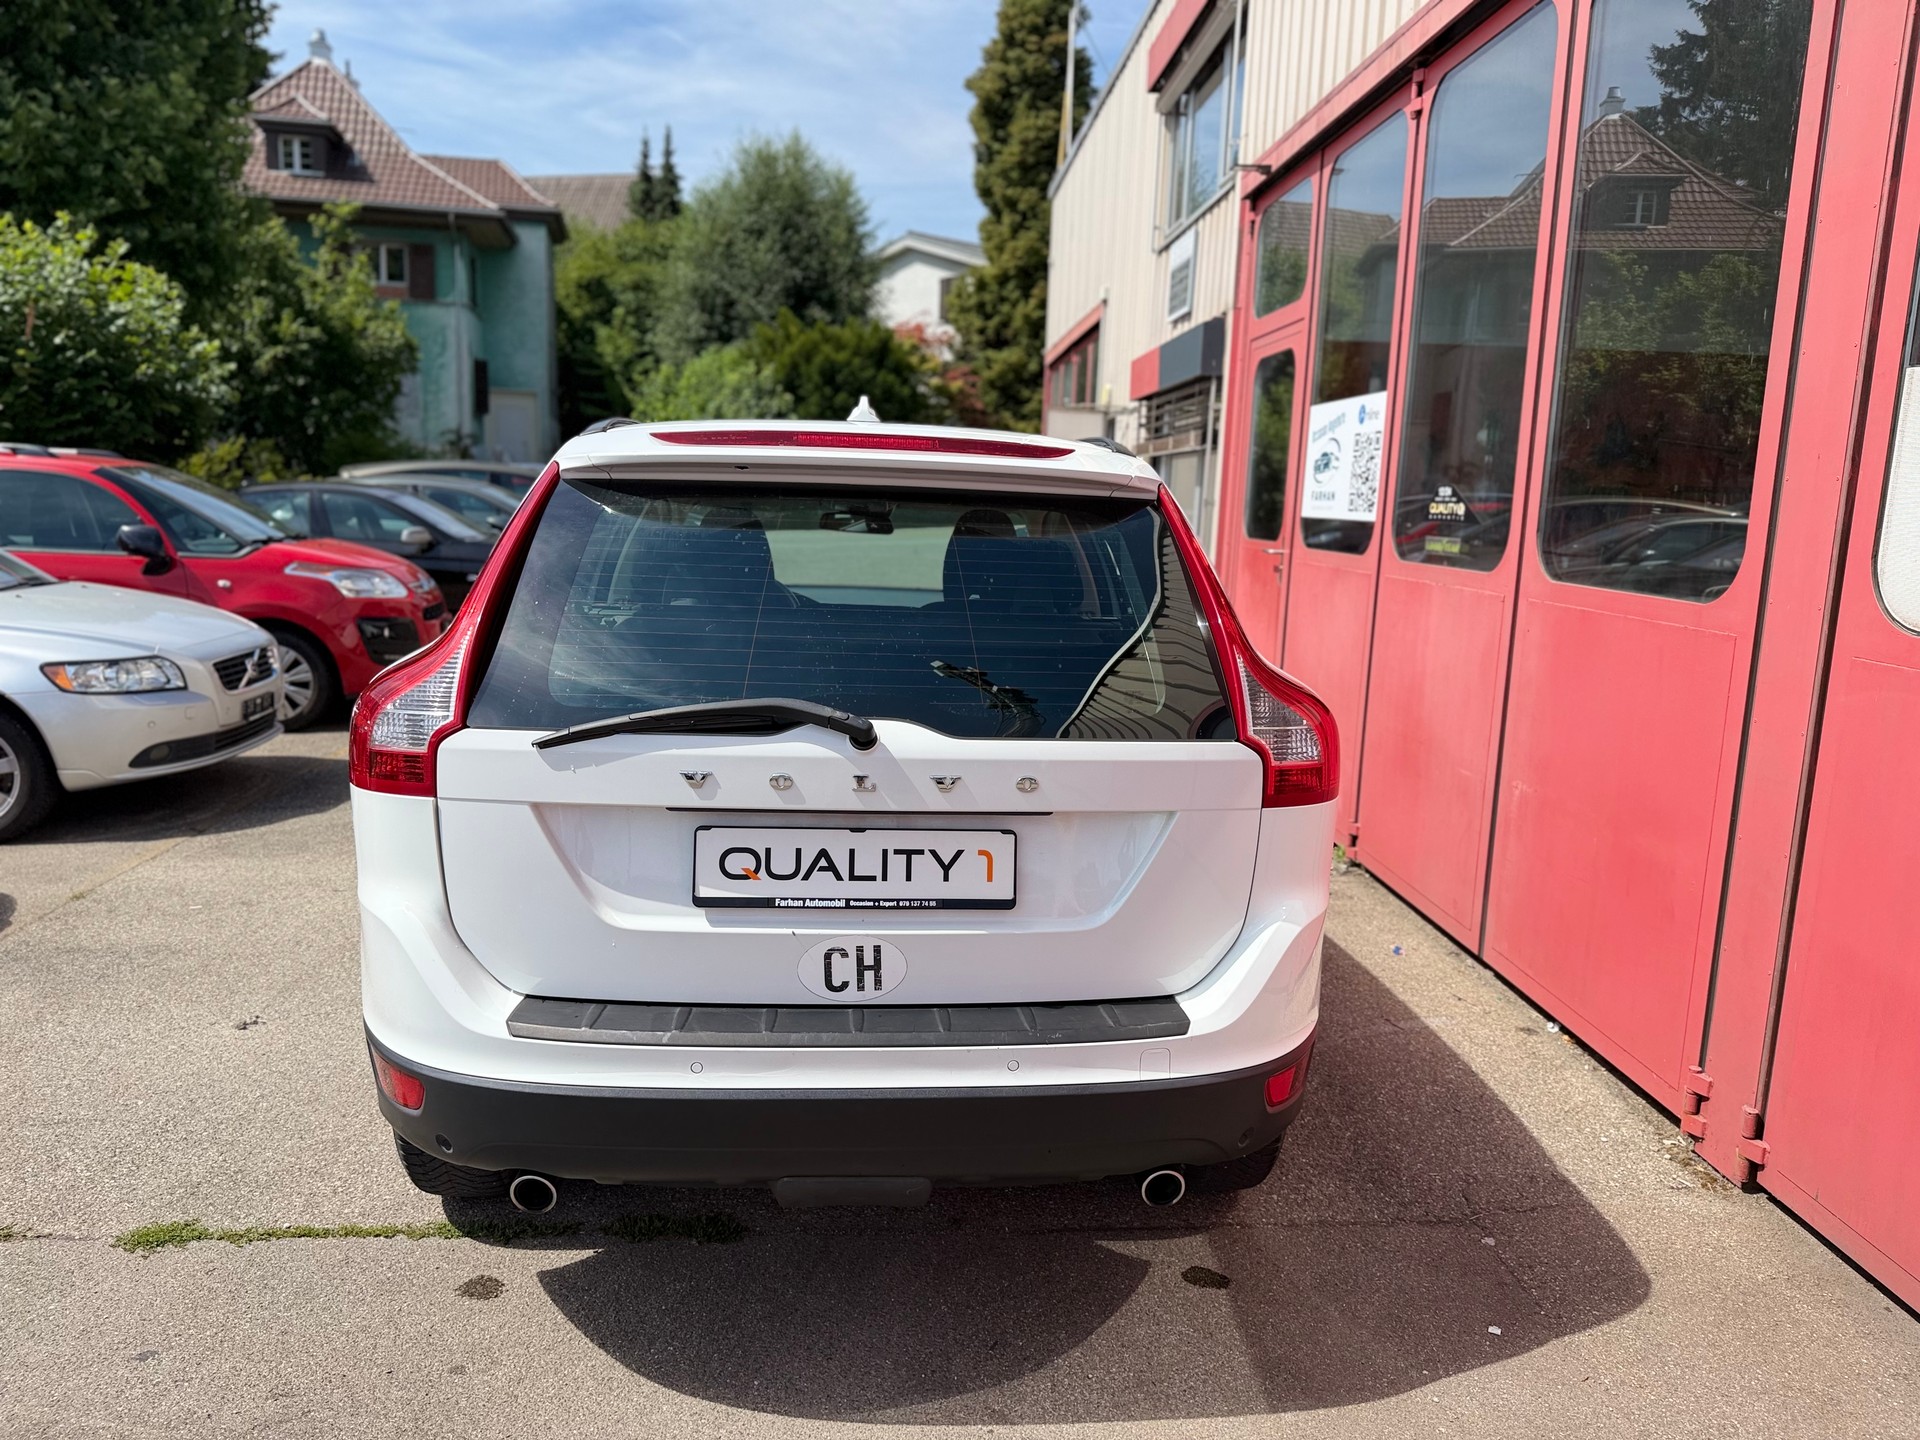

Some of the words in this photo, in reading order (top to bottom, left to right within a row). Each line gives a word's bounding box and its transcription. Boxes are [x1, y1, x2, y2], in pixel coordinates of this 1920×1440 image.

[679, 769, 1040, 793] VOLVO
[718, 846, 965, 882] QUALITY
[977, 849, 994, 883] 1
[775, 898, 803, 907] Farhan
[804, 898, 846, 907] Automobil
[823, 944, 883, 993] CH
